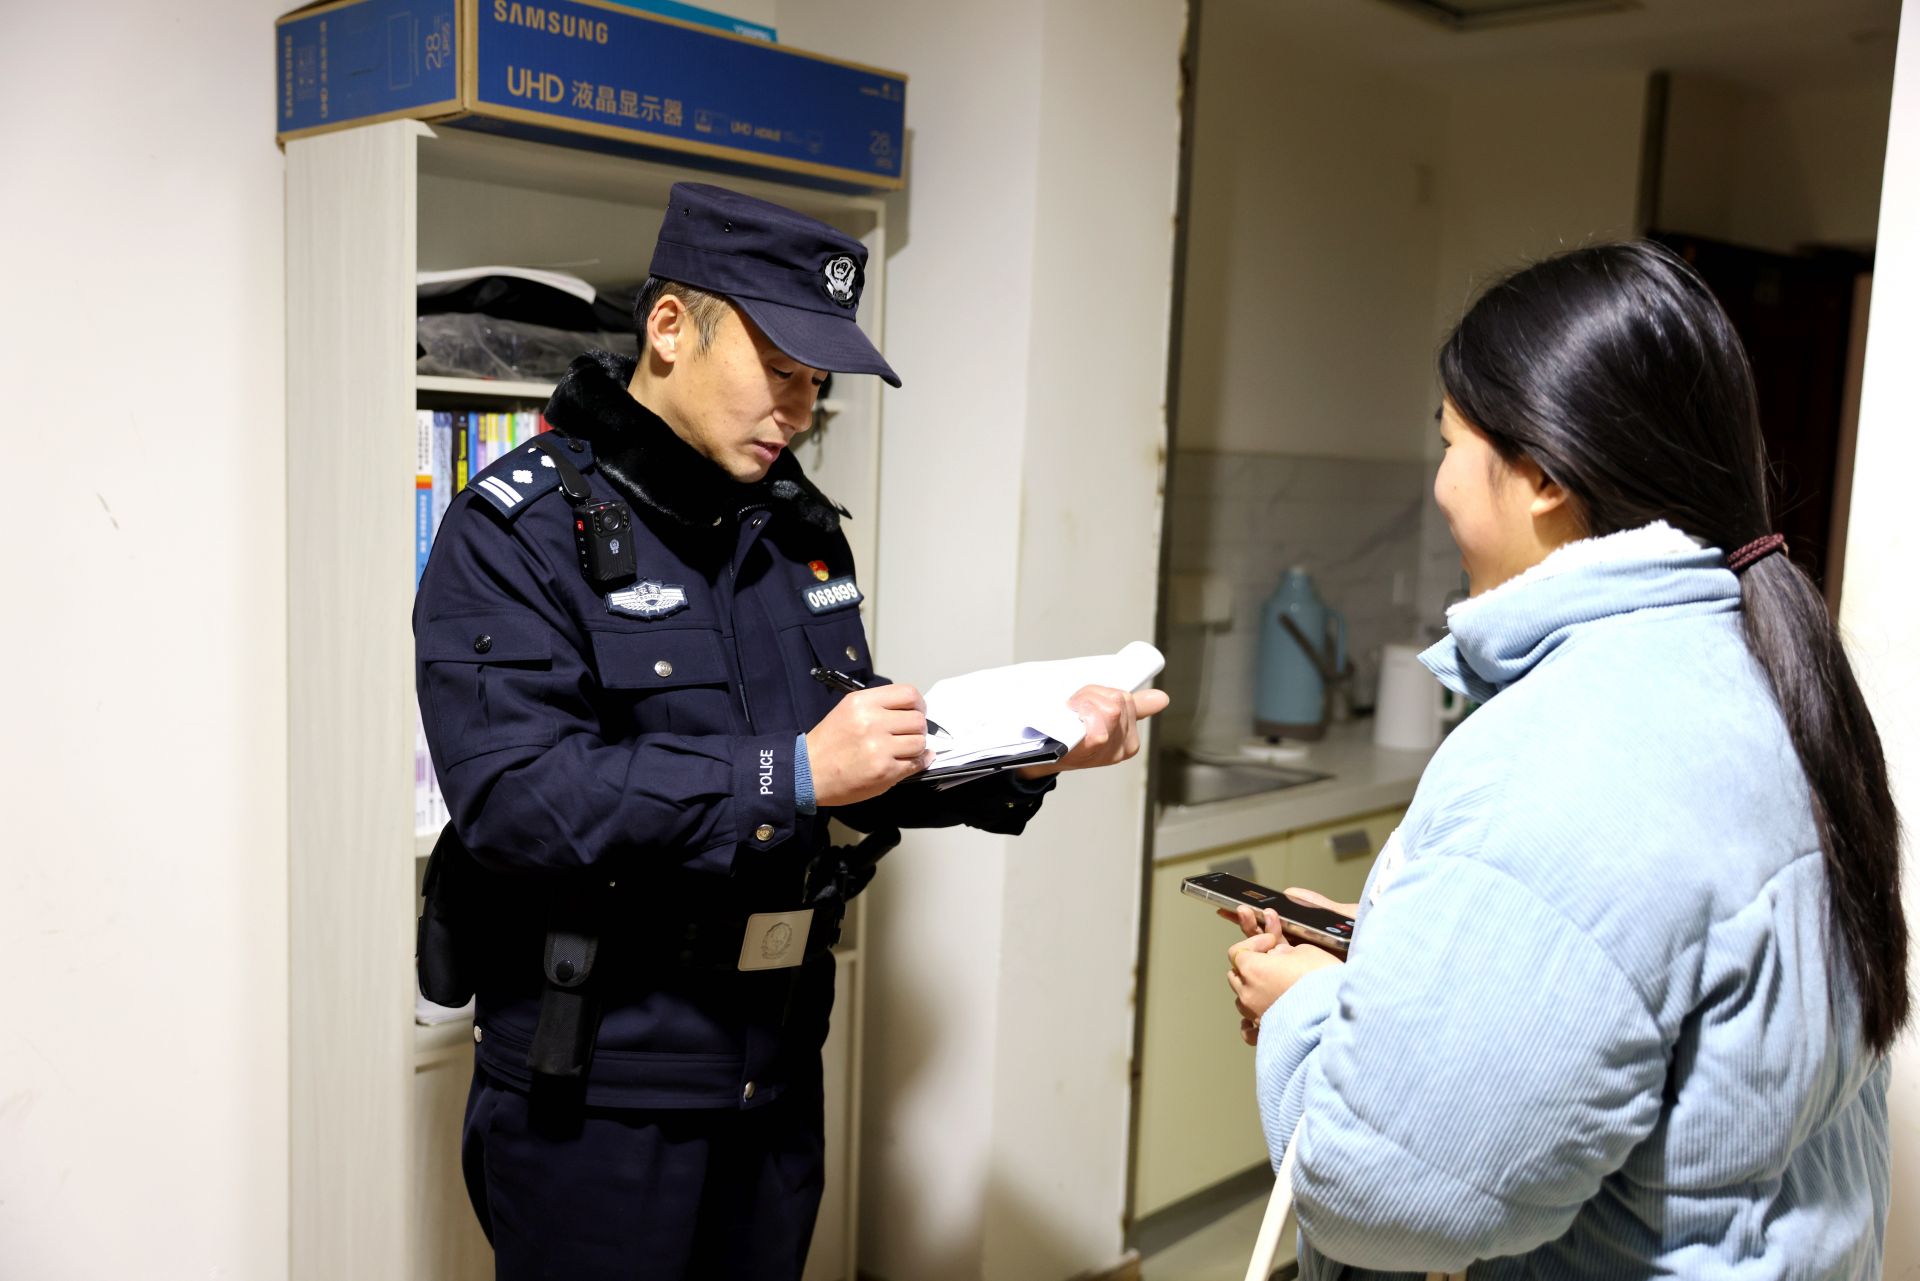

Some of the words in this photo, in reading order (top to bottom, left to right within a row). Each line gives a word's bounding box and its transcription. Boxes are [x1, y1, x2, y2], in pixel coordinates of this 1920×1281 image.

[494, 0, 609, 44] SAMSUNG
[425, 32, 441, 70] 28
[507, 65, 564, 103] UHD
[571, 79, 683, 127] 液晶显示器
[759, 749, 774, 795] POLICE
